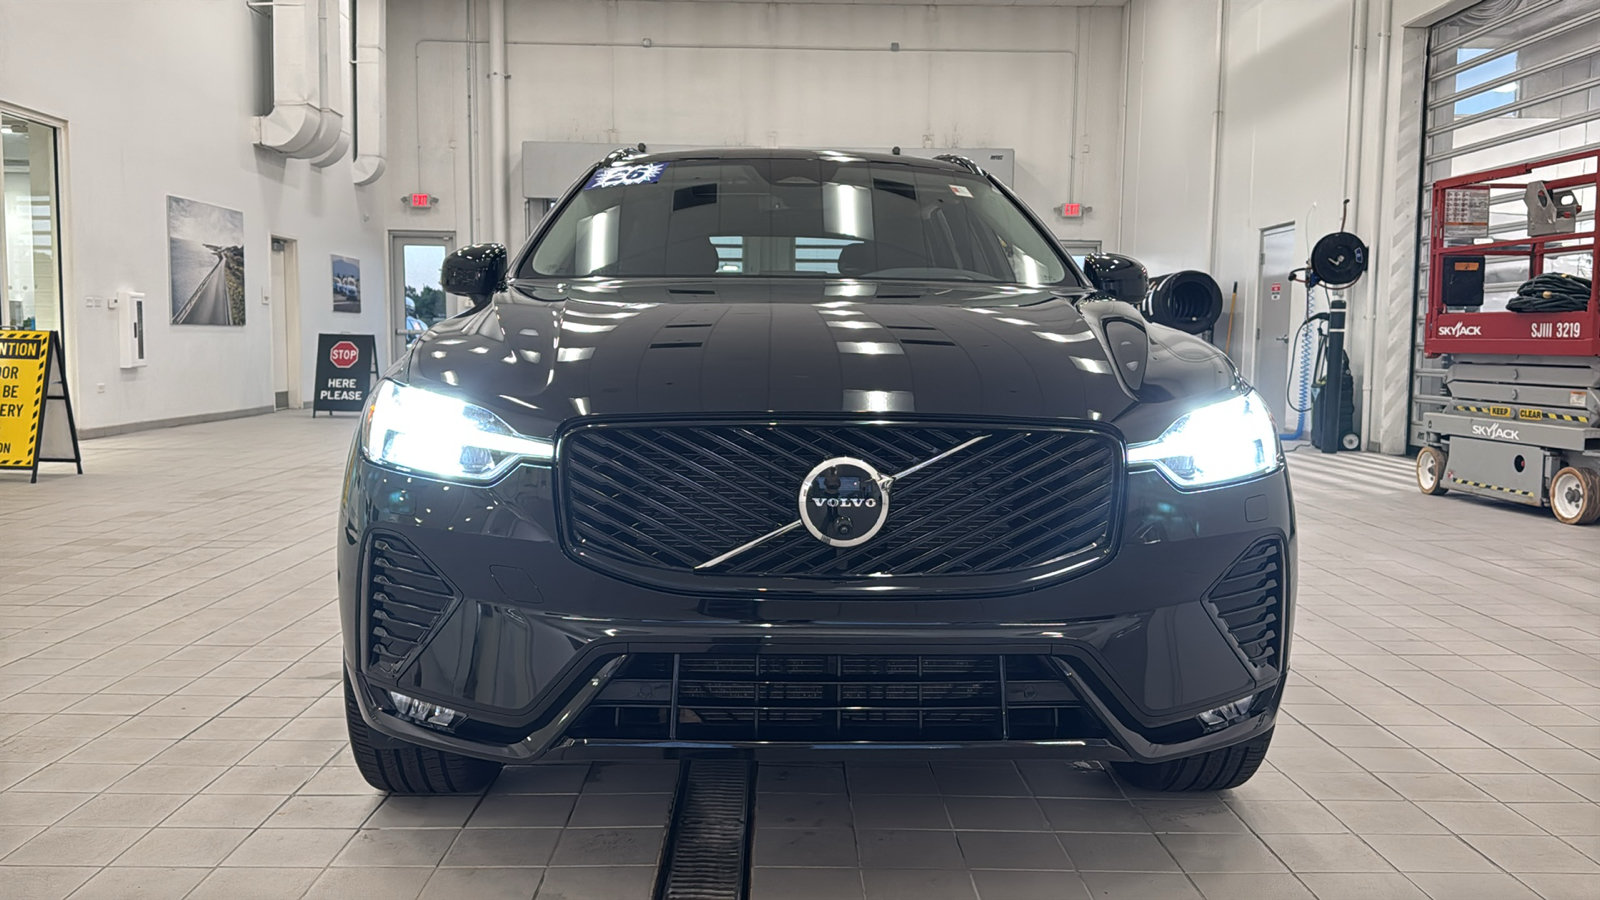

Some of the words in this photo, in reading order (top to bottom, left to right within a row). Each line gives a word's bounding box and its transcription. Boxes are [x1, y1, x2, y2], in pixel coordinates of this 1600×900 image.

[1438, 321, 1481, 337] SKYJACK
[1531, 322, 1553, 338] SJIII
[1556, 322, 1581, 338] 3219
[332, 349, 357, 360] STOP
[328, 378, 357, 388] HERE
[3, 385, 19, 398] BE
[320, 390, 363, 400] PLEASE
[0, 404, 24, 417] ERY
[1492, 407, 1509, 416] KEEP
[1520, 409, 1541, 418] CLEAR
[1471, 423, 1520, 441] SKYJACK
[812, 497, 877, 508] VOLVO
